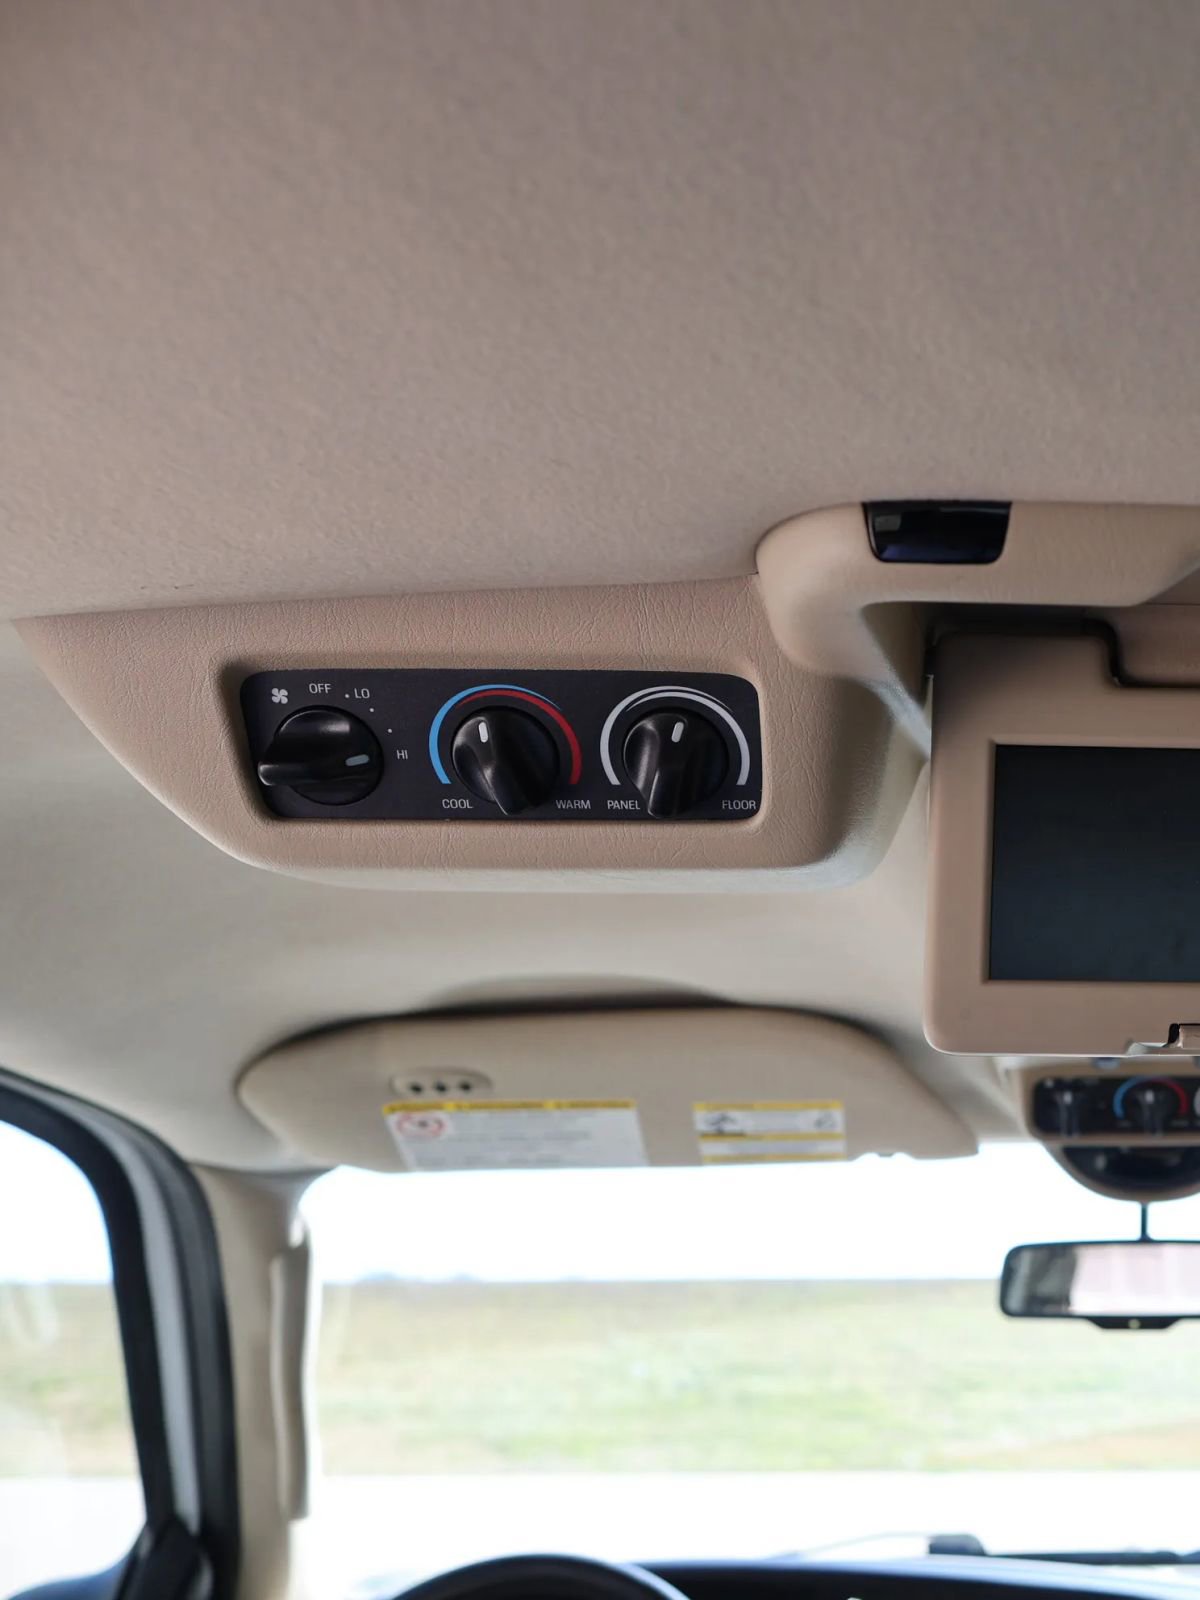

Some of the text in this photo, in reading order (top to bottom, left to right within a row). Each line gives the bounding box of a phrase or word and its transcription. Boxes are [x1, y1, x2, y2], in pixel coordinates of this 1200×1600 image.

[308, 683, 332, 694] OFF
[354, 687, 371, 699] LO
[396, 749, 409, 760] HI
[441, 798, 474, 809] COOL
[555, 799, 592, 810] WARM
[607, 799, 641, 810] PANEL
[722, 799, 757, 810] FLOOR
